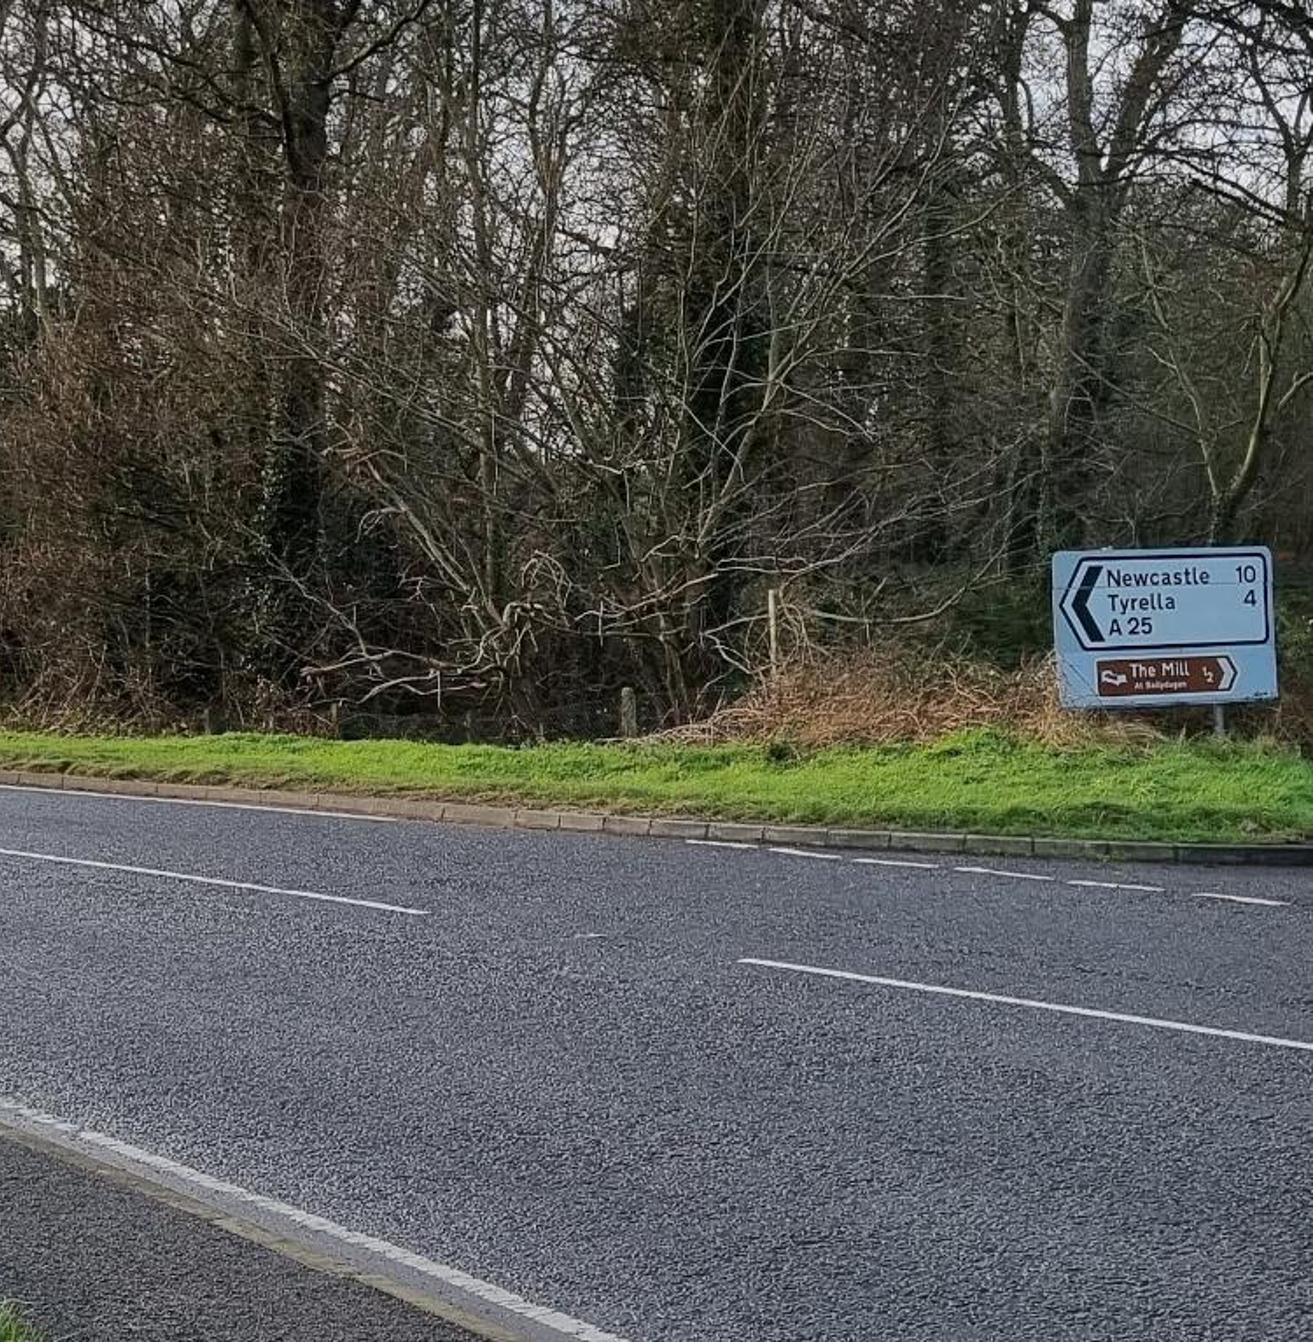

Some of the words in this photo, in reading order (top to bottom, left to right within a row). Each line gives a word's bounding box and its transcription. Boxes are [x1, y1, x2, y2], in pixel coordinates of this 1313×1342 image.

[1106, 568, 1211, 588] Newcastle
[1235, 565, 1256, 583] 10
[1107, 593, 1176, 615] Tyrella
[1244, 590, 1257, 606] 4
[1108, 619, 1122, 636] A
[1128, 618, 1153, 635] 25
[1129, 663, 1157, 678] The
[1161, 660, 1190, 677] Mill
